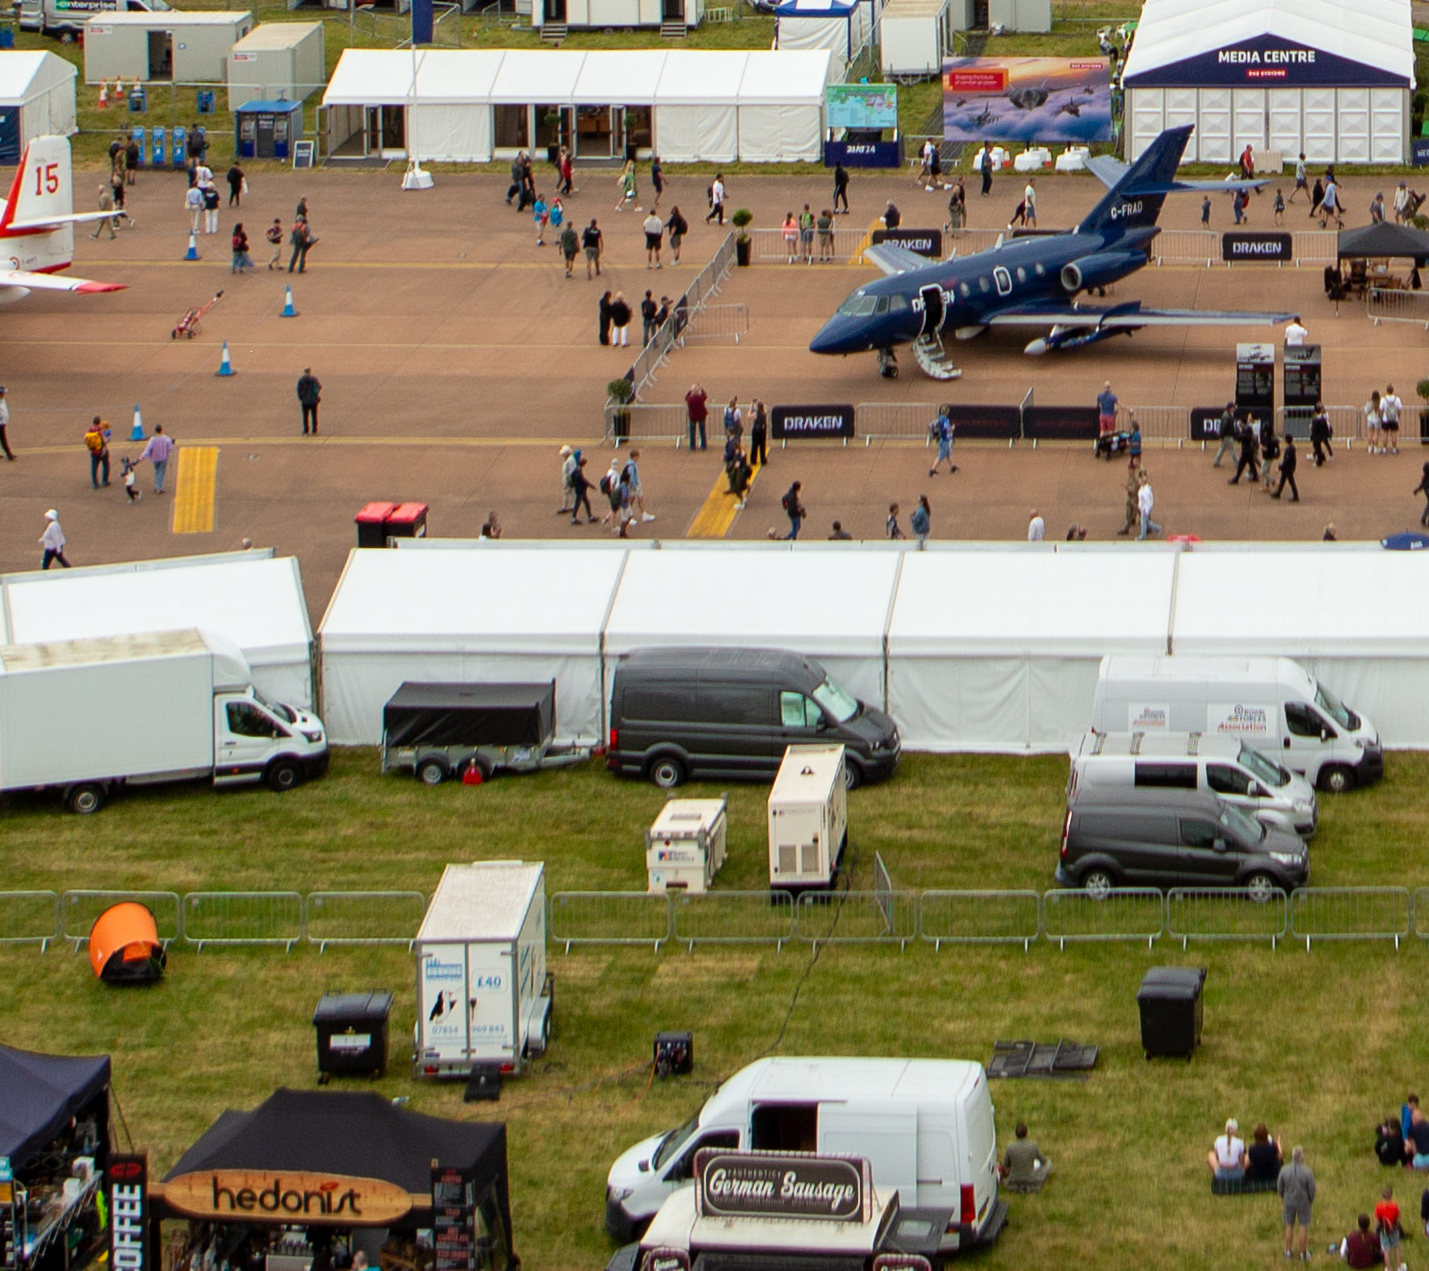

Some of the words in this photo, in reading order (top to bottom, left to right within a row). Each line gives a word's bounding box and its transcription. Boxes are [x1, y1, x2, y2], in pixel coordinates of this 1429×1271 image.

[57, 0, 117, 11] enterprise
[1218, 50, 1261, 64] MEDIA
[1263, 49, 1316, 64] CENTRE
[34, 163, 60, 196] 15
[1110, 200, 1143, 221] G-FRAD
[1232, 241, 1282, 255] DRAKEN
[783, 414, 843, 431] DRAKEN
[1218, 721, 1267, 732] Association
[477, 974, 502, 989] £40
[211, 1175, 364, 1217] hedonist
[708, 1167, 777, 1197] German
[779, 1170, 857, 1213] Sausage
[112, 1183, 144, 1271] OFFEE
